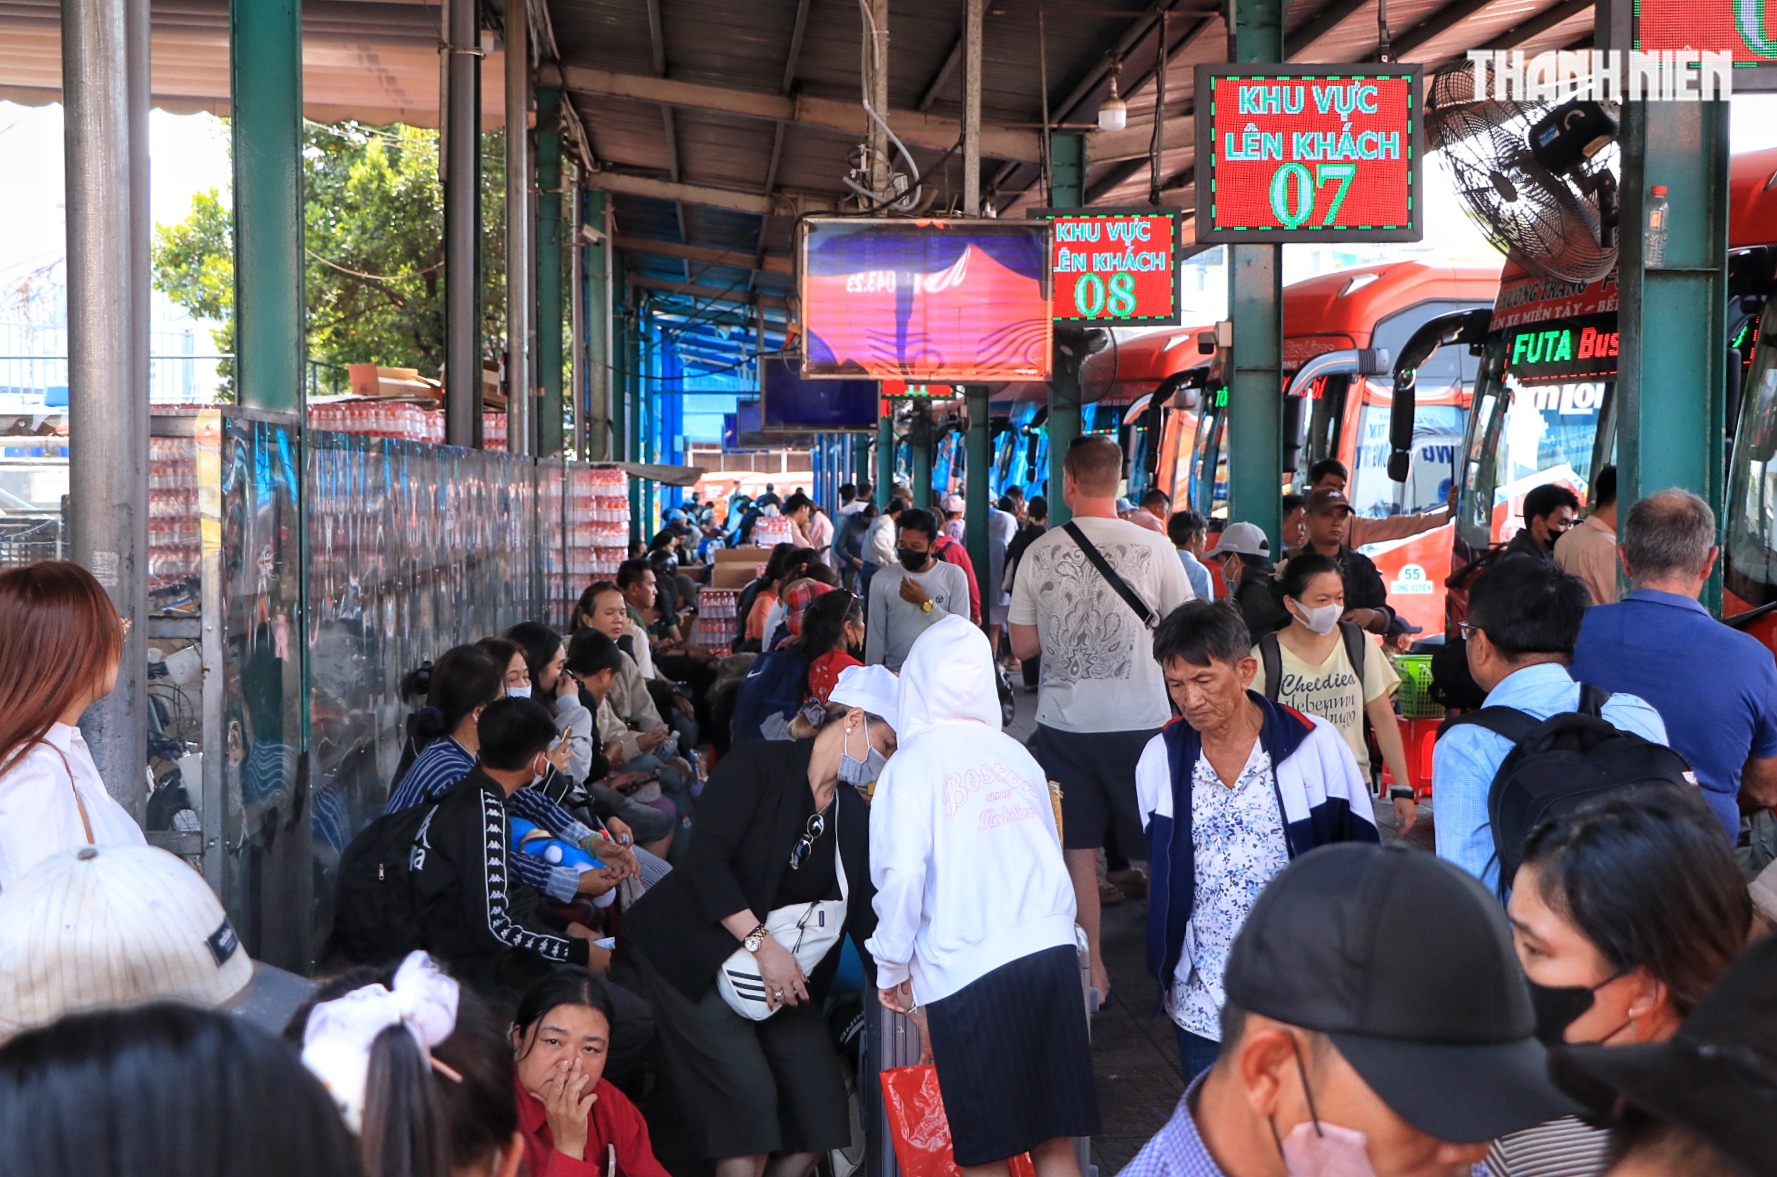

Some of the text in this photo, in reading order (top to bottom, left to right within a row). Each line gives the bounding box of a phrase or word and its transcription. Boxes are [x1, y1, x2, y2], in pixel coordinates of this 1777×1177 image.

[1239, 80, 1378, 122] KHU VỰC
[1225, 121, 1400, 161] LÊN KHÁCH
[1269, 161, 1357, 228] 07
[1056, 217, 1152, 246] KHU VỰC
[1093, 245, 1166, 272] KHÁCH
[1074, 271, 1138, 317] 08
[1554, 301, 1583, 319] TÂY
[1596, 292, 1618, 313] BẾ
[1511, 329, 1572, 365] FUTA
[1404, 568, 1421, 580] 55
[942, 762, 1040, 820] Boston
